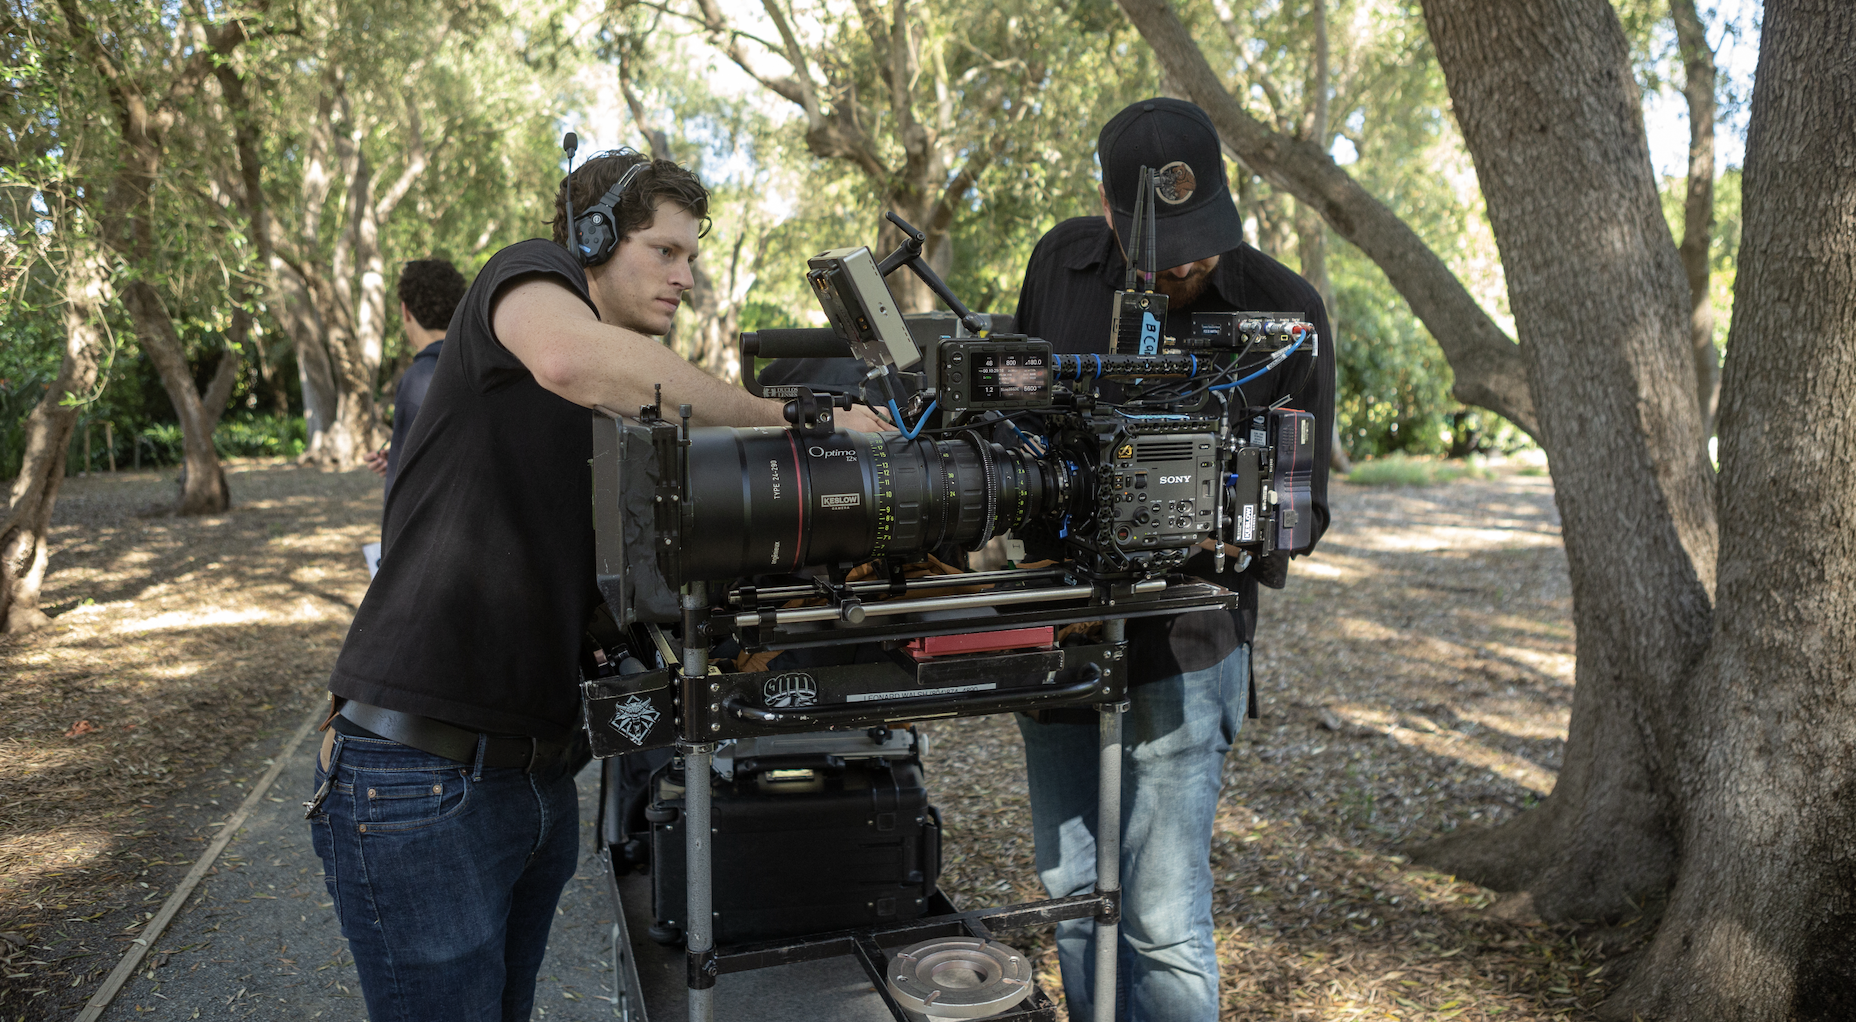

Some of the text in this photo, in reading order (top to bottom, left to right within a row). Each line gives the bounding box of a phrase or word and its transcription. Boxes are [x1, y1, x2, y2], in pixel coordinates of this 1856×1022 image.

[1146, 324, 1156, 332] B
[808, 446, 856, 458] Optimo
[1160, 475, 1192, 484] SONY
[772, 483, 781, 500] TYPE
[823, 496, 858, 505] KESLOW
[1243, 506, 1253, 539] KESLOW
